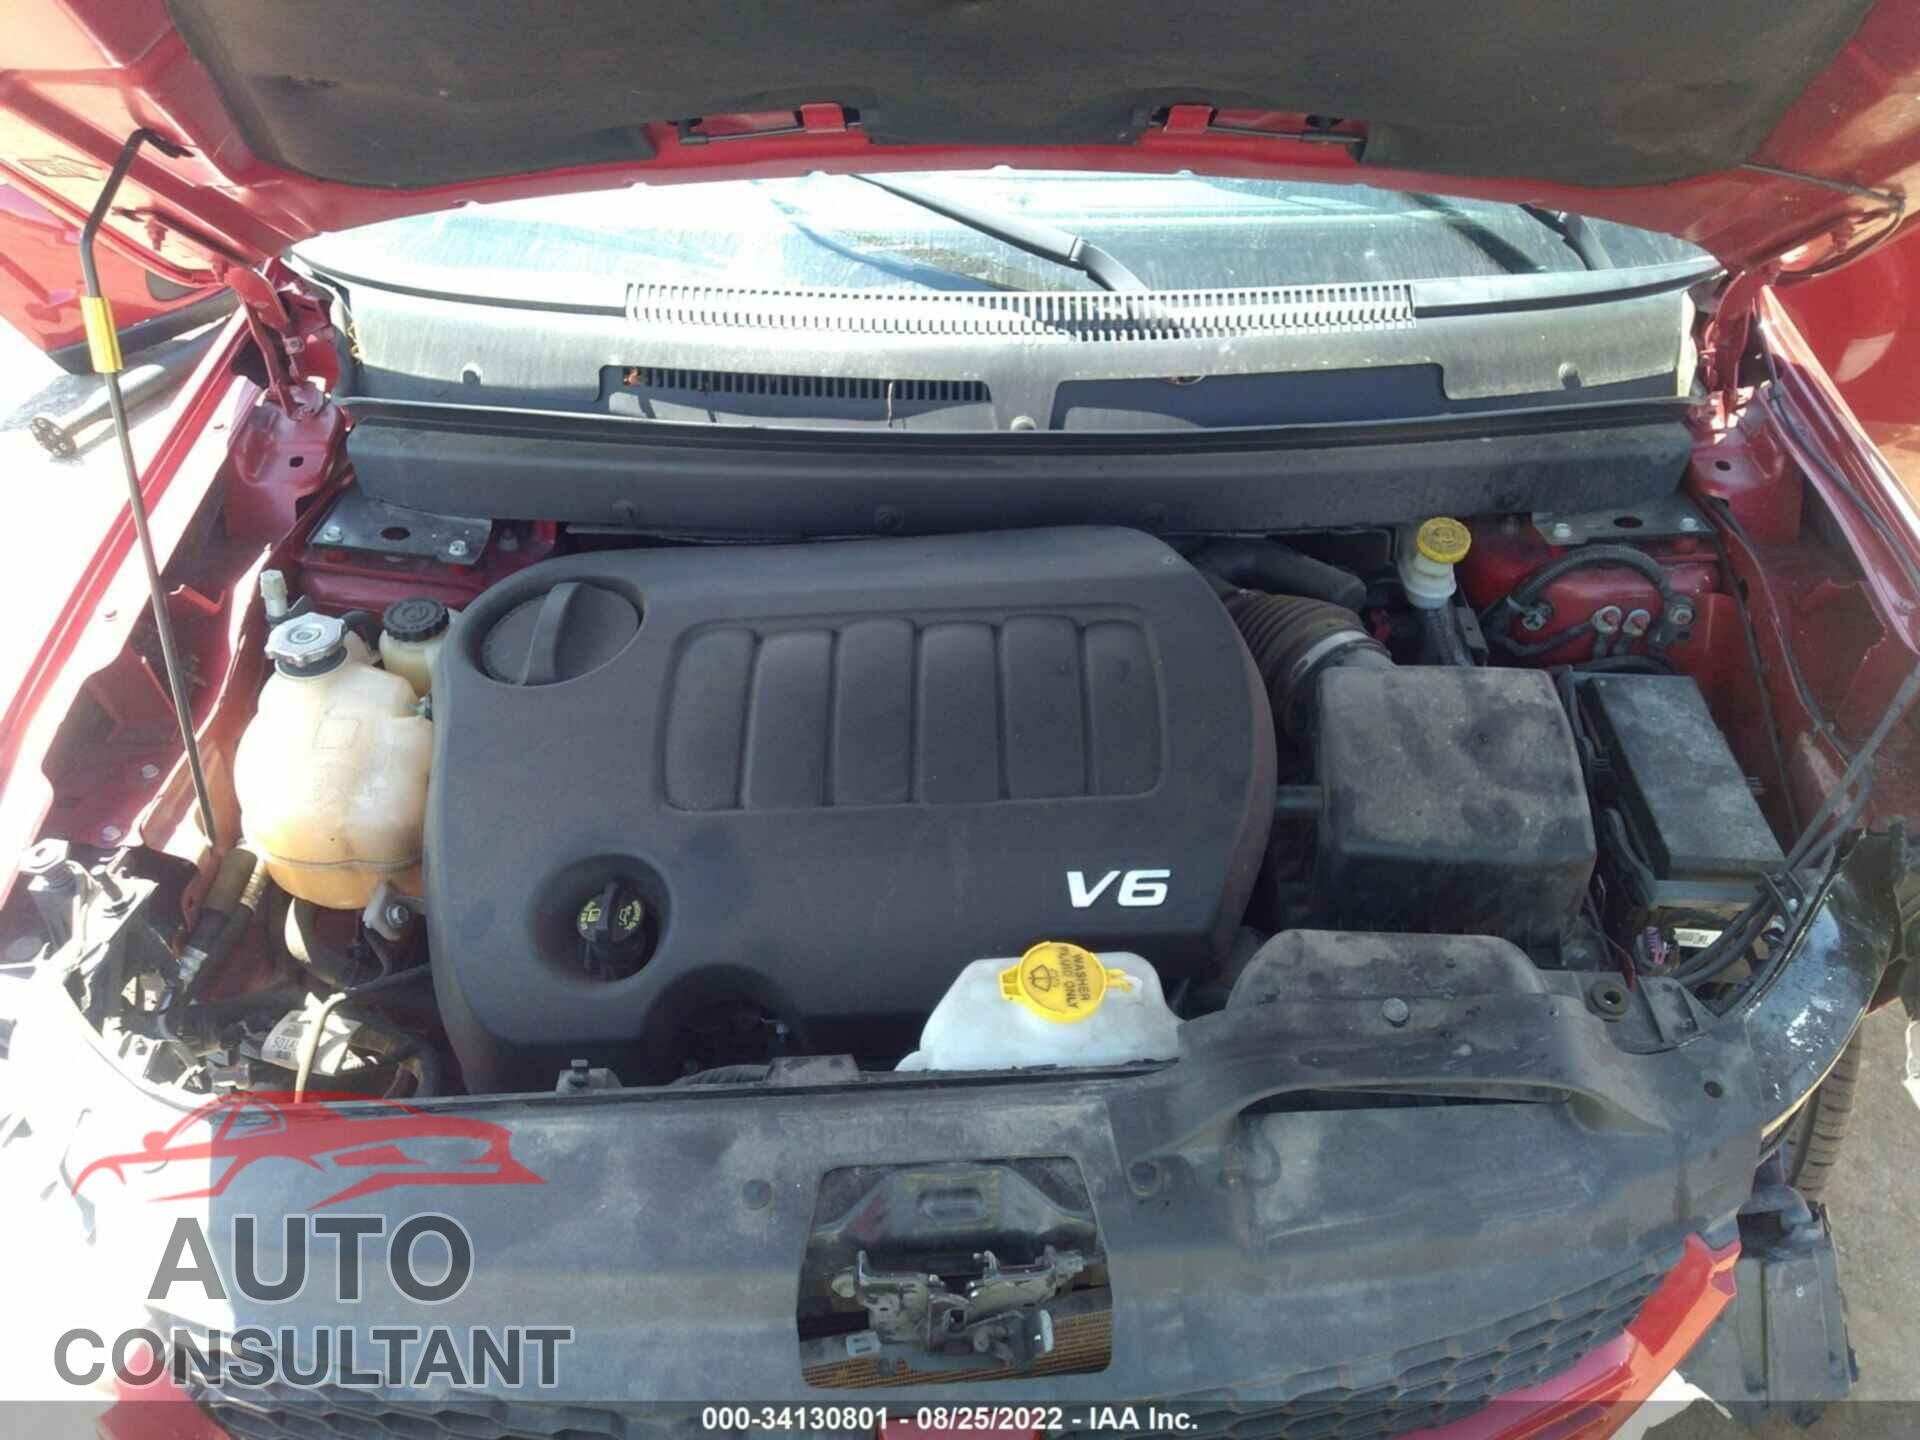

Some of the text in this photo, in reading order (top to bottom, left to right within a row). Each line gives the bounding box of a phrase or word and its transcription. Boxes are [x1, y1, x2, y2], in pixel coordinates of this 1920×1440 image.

[1066, 868, 1171, 908] V6
[1064, 981, 1080, 1009] ONLY
[1073, 953, 1090, 1001] WASHER
